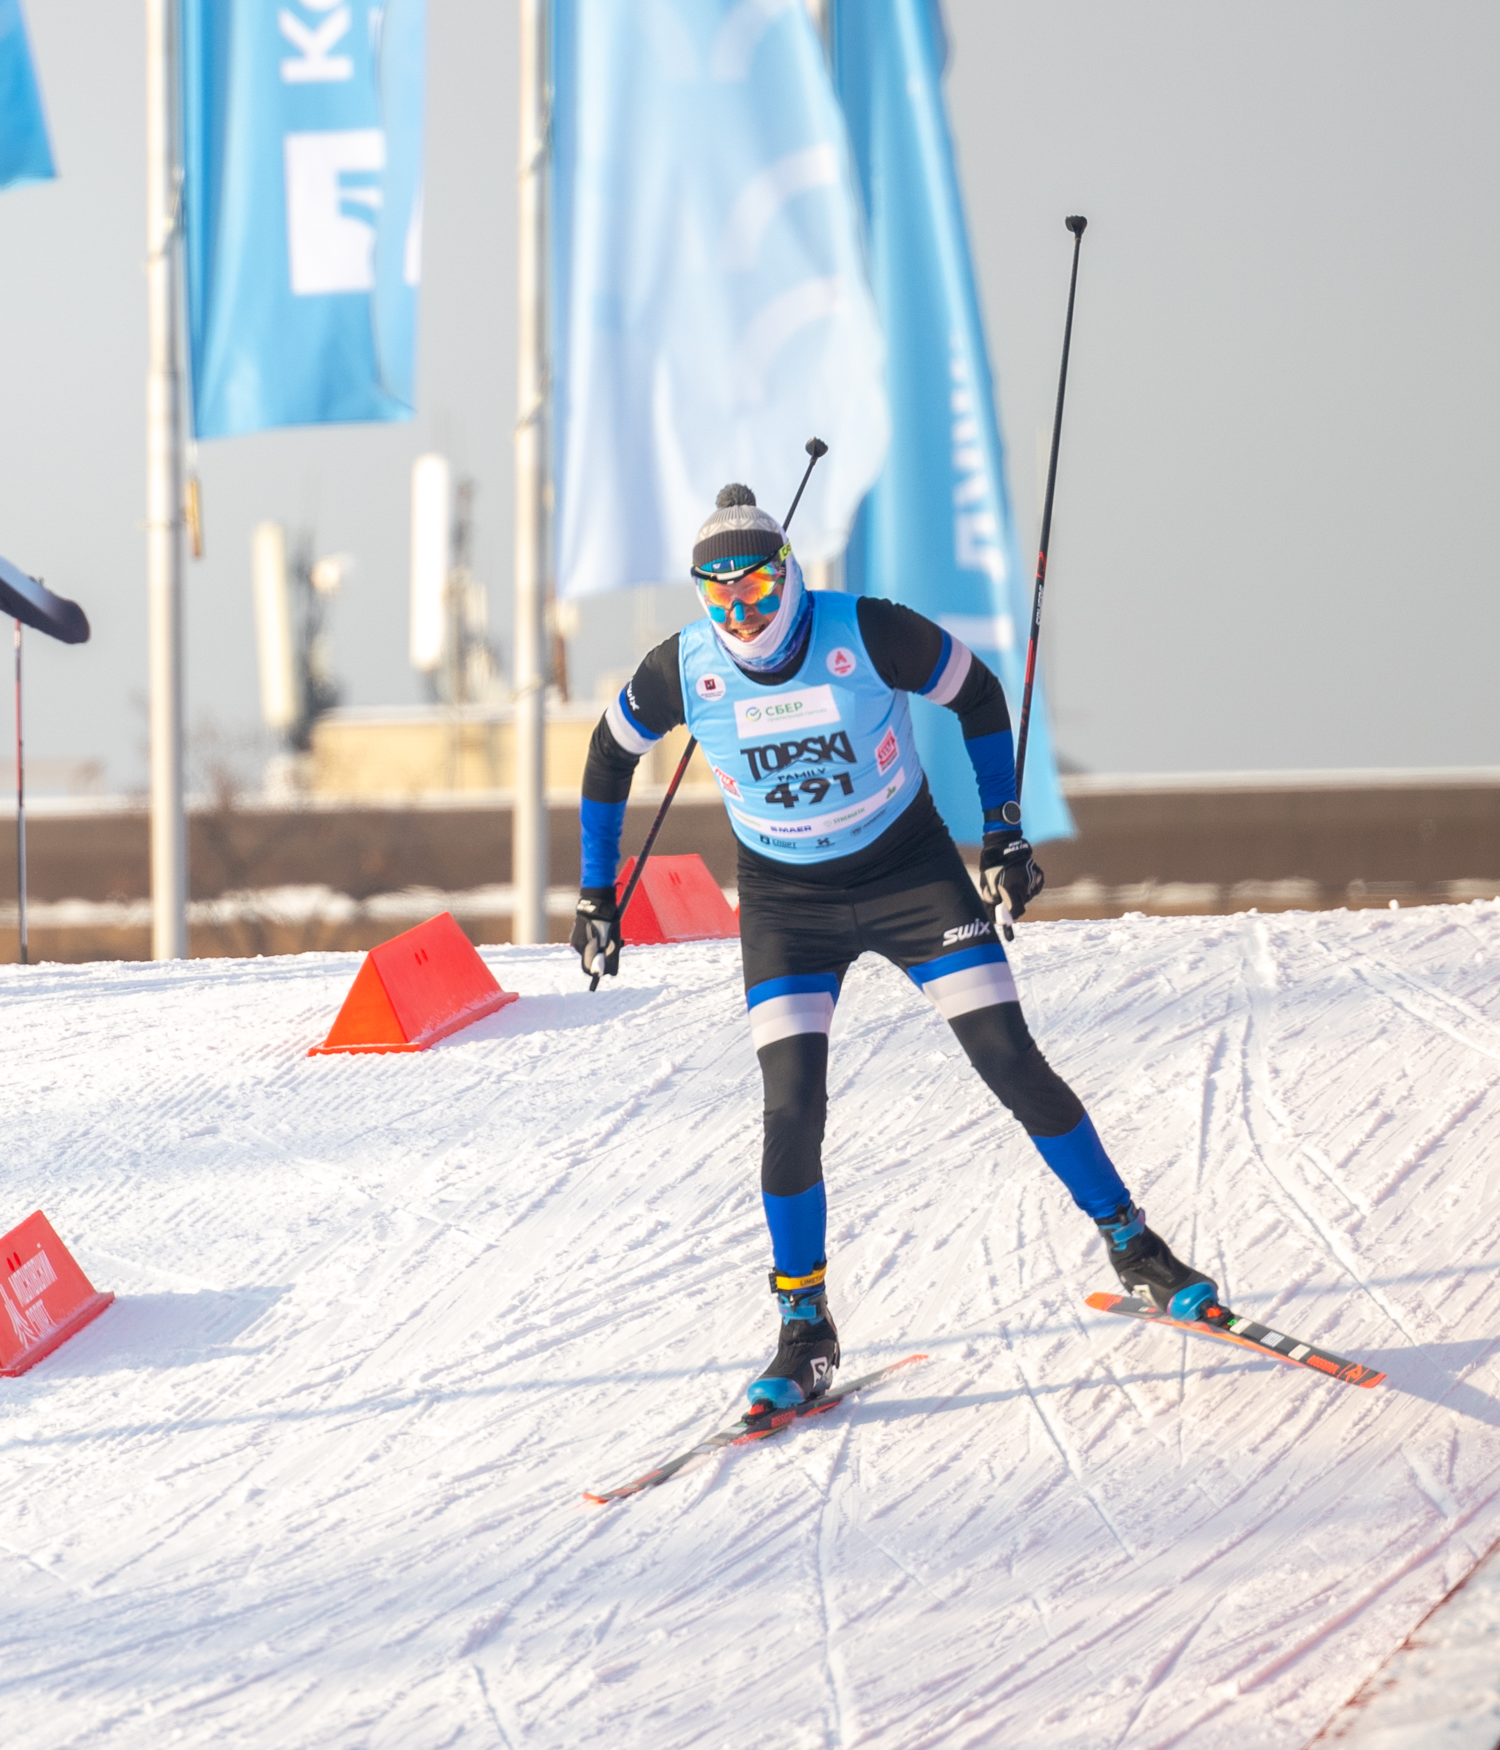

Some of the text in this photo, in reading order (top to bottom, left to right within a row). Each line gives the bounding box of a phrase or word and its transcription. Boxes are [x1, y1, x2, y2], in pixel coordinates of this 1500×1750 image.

[765, 701, 803, 716] СБЕР
[740, 730, 857, 782] TOPSKI
[777, 767, 827, 782] FAMILY
[765, 772, 854, 808] 491
